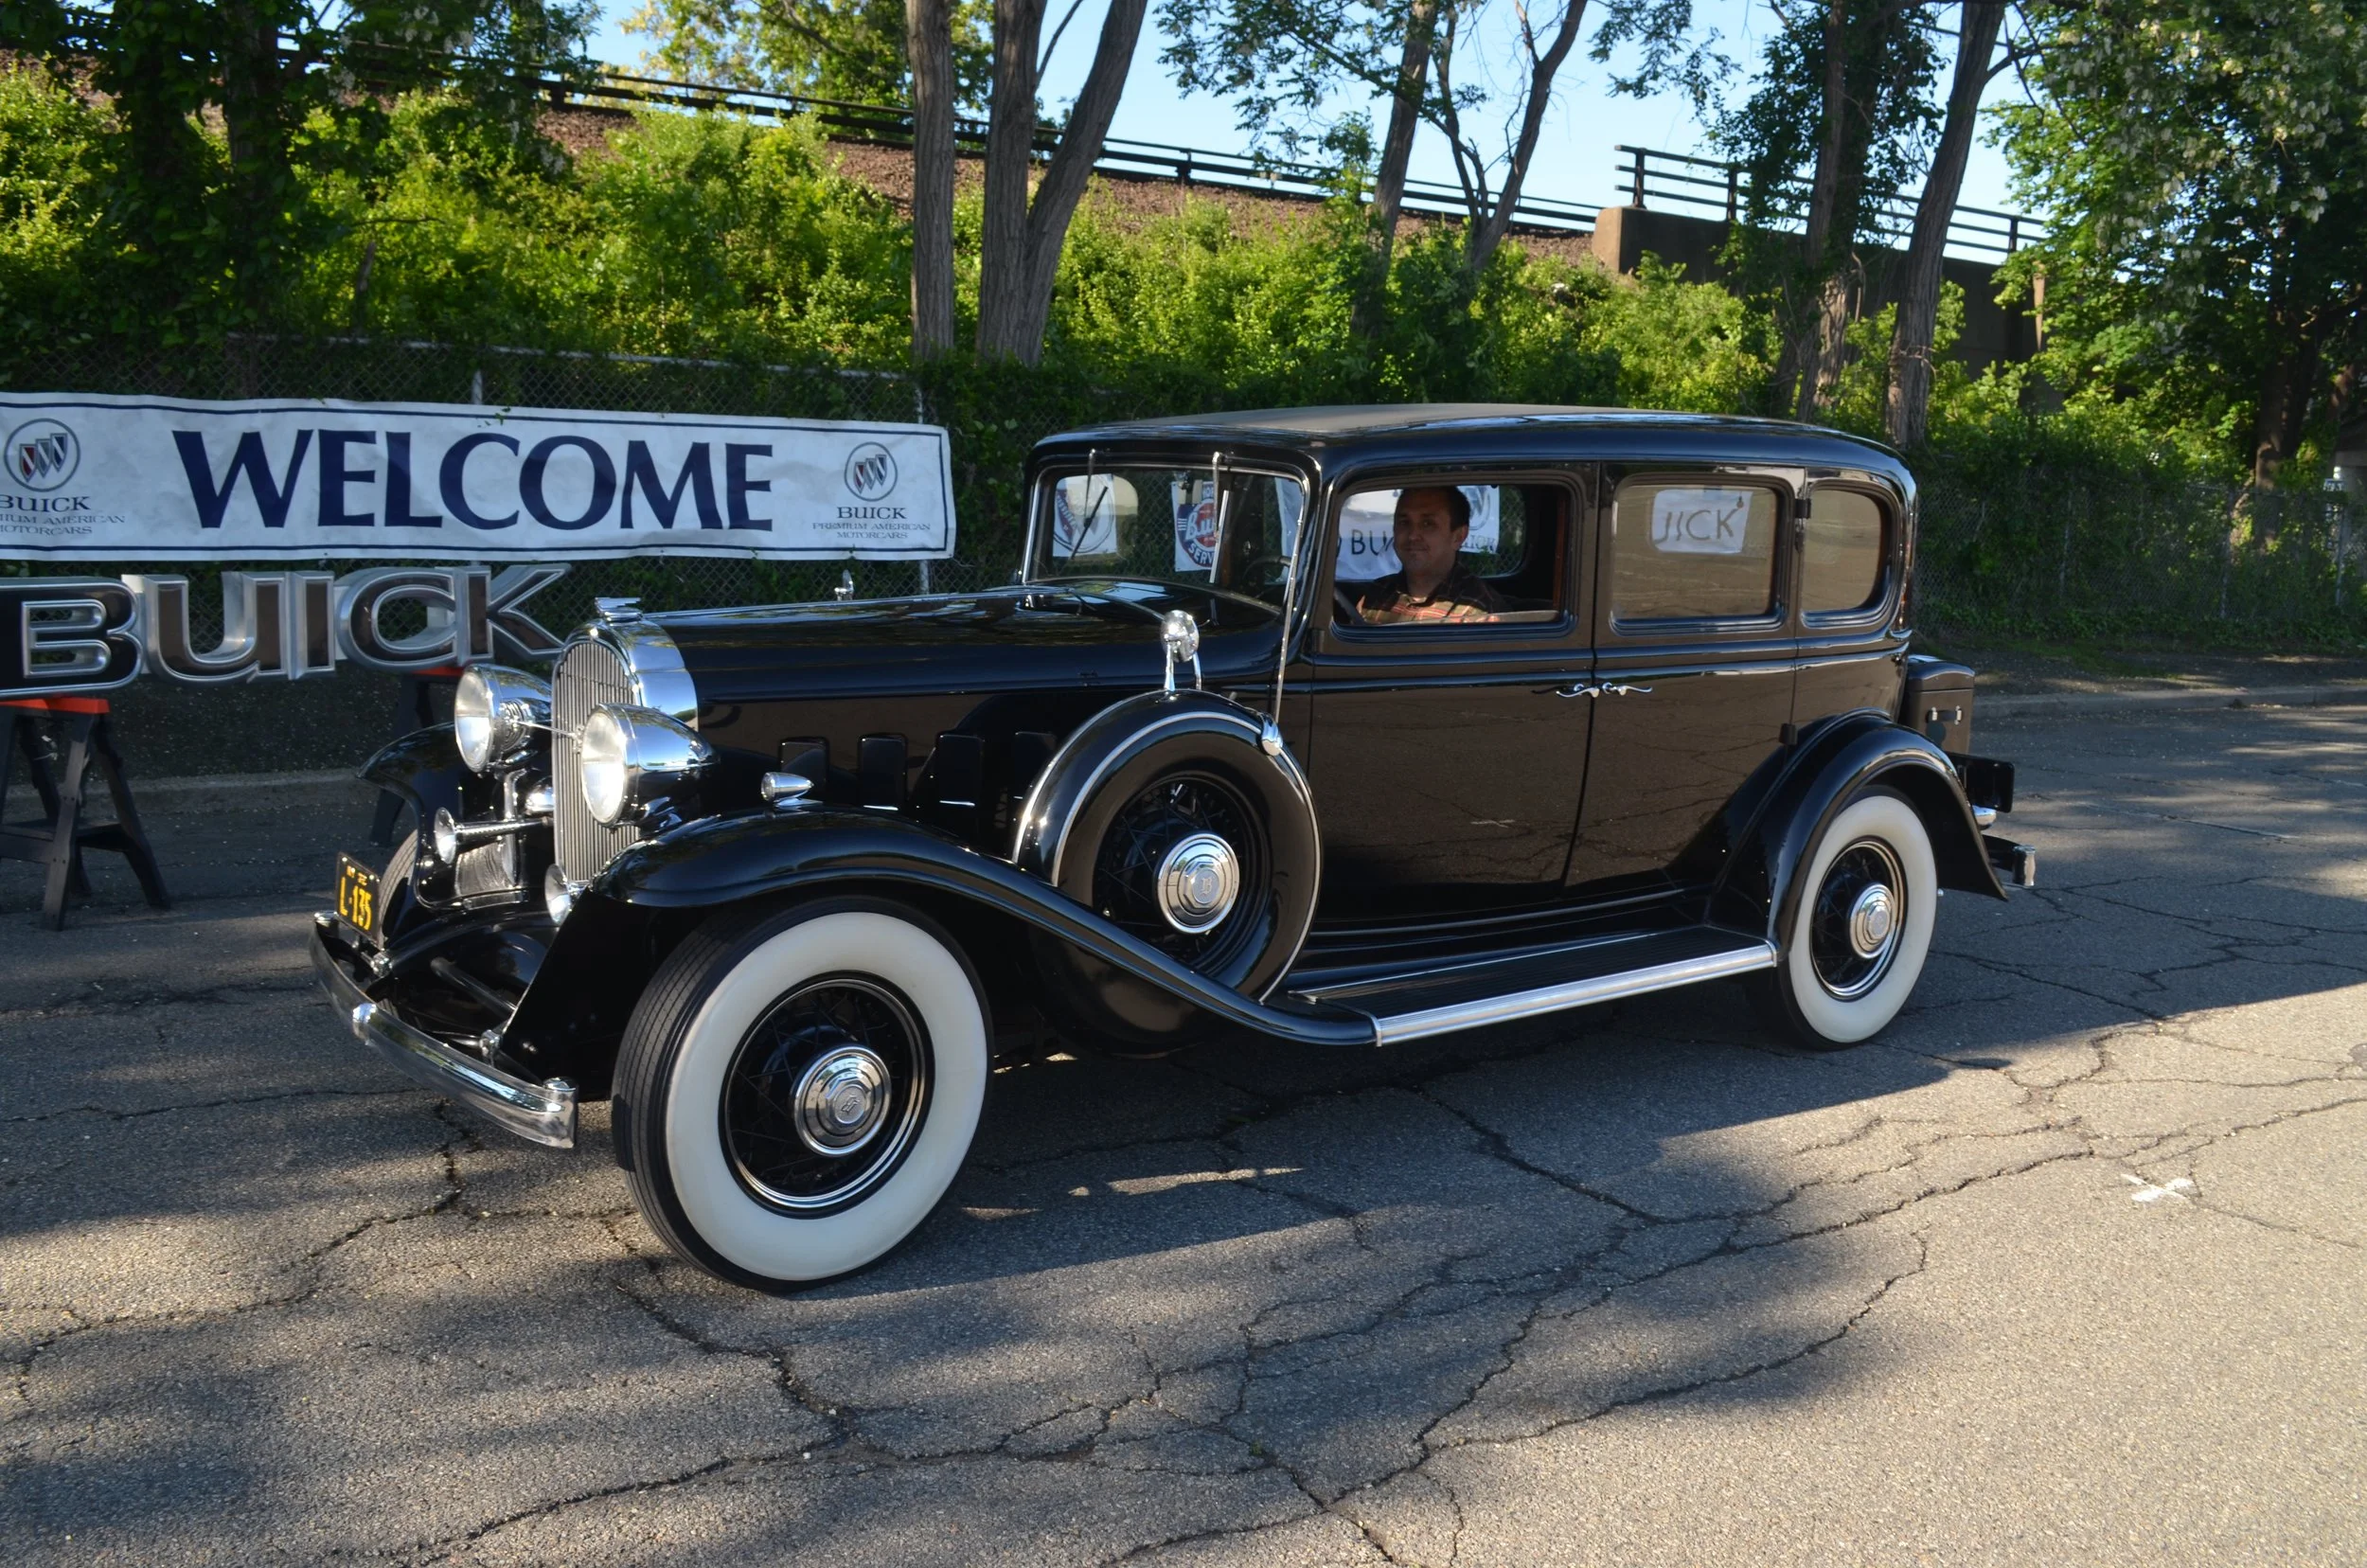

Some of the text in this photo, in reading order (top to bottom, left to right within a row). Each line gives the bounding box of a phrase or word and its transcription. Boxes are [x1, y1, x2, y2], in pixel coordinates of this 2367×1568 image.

[171, 428, 773, 532] WELCOME
[0, 494, 92, 512] BUICK
[44, 515, 126, 526] AMERICAN
[837, 507, 907, 519] BUICK
[0, 564, 570, 699] BUICK
